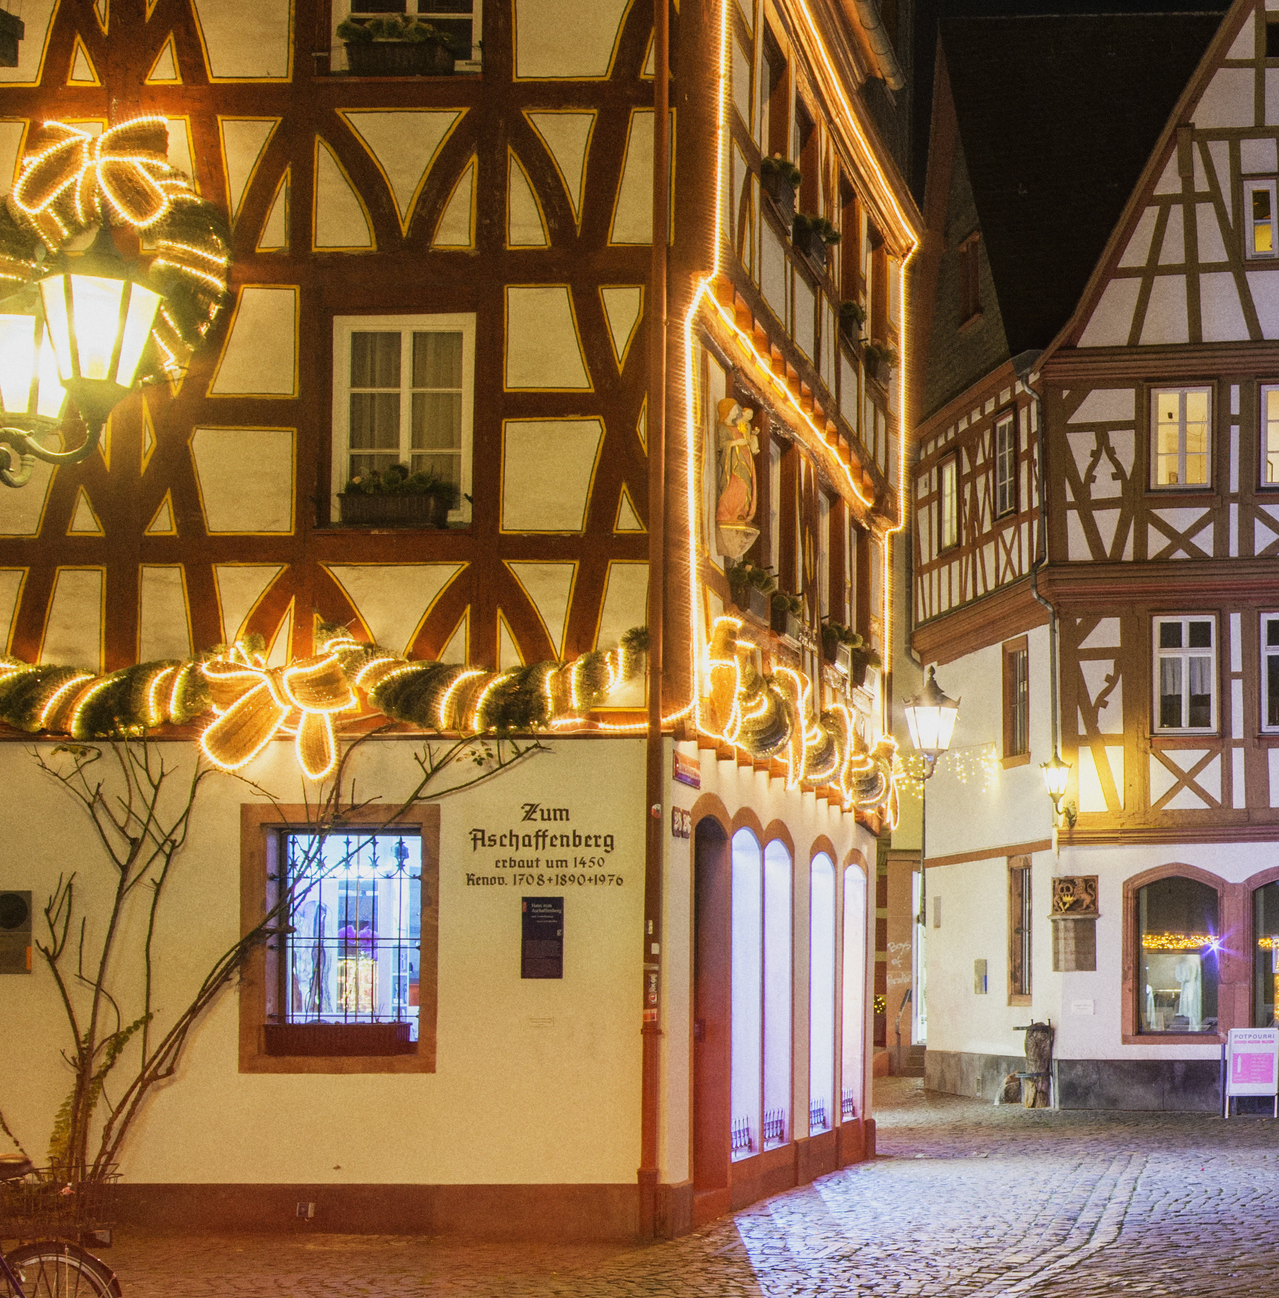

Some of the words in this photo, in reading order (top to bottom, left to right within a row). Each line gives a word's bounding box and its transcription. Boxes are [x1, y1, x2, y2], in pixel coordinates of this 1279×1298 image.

[520, 802, 571, 823] Zum
[468, 828, 615, 853] Aschaffenberg
[495, 856, 541, 869] erbaut
[545, 859, 569, 869] um
[573, 856, 606, 869] 1450
[466, 873, 508, 886] Renov.
